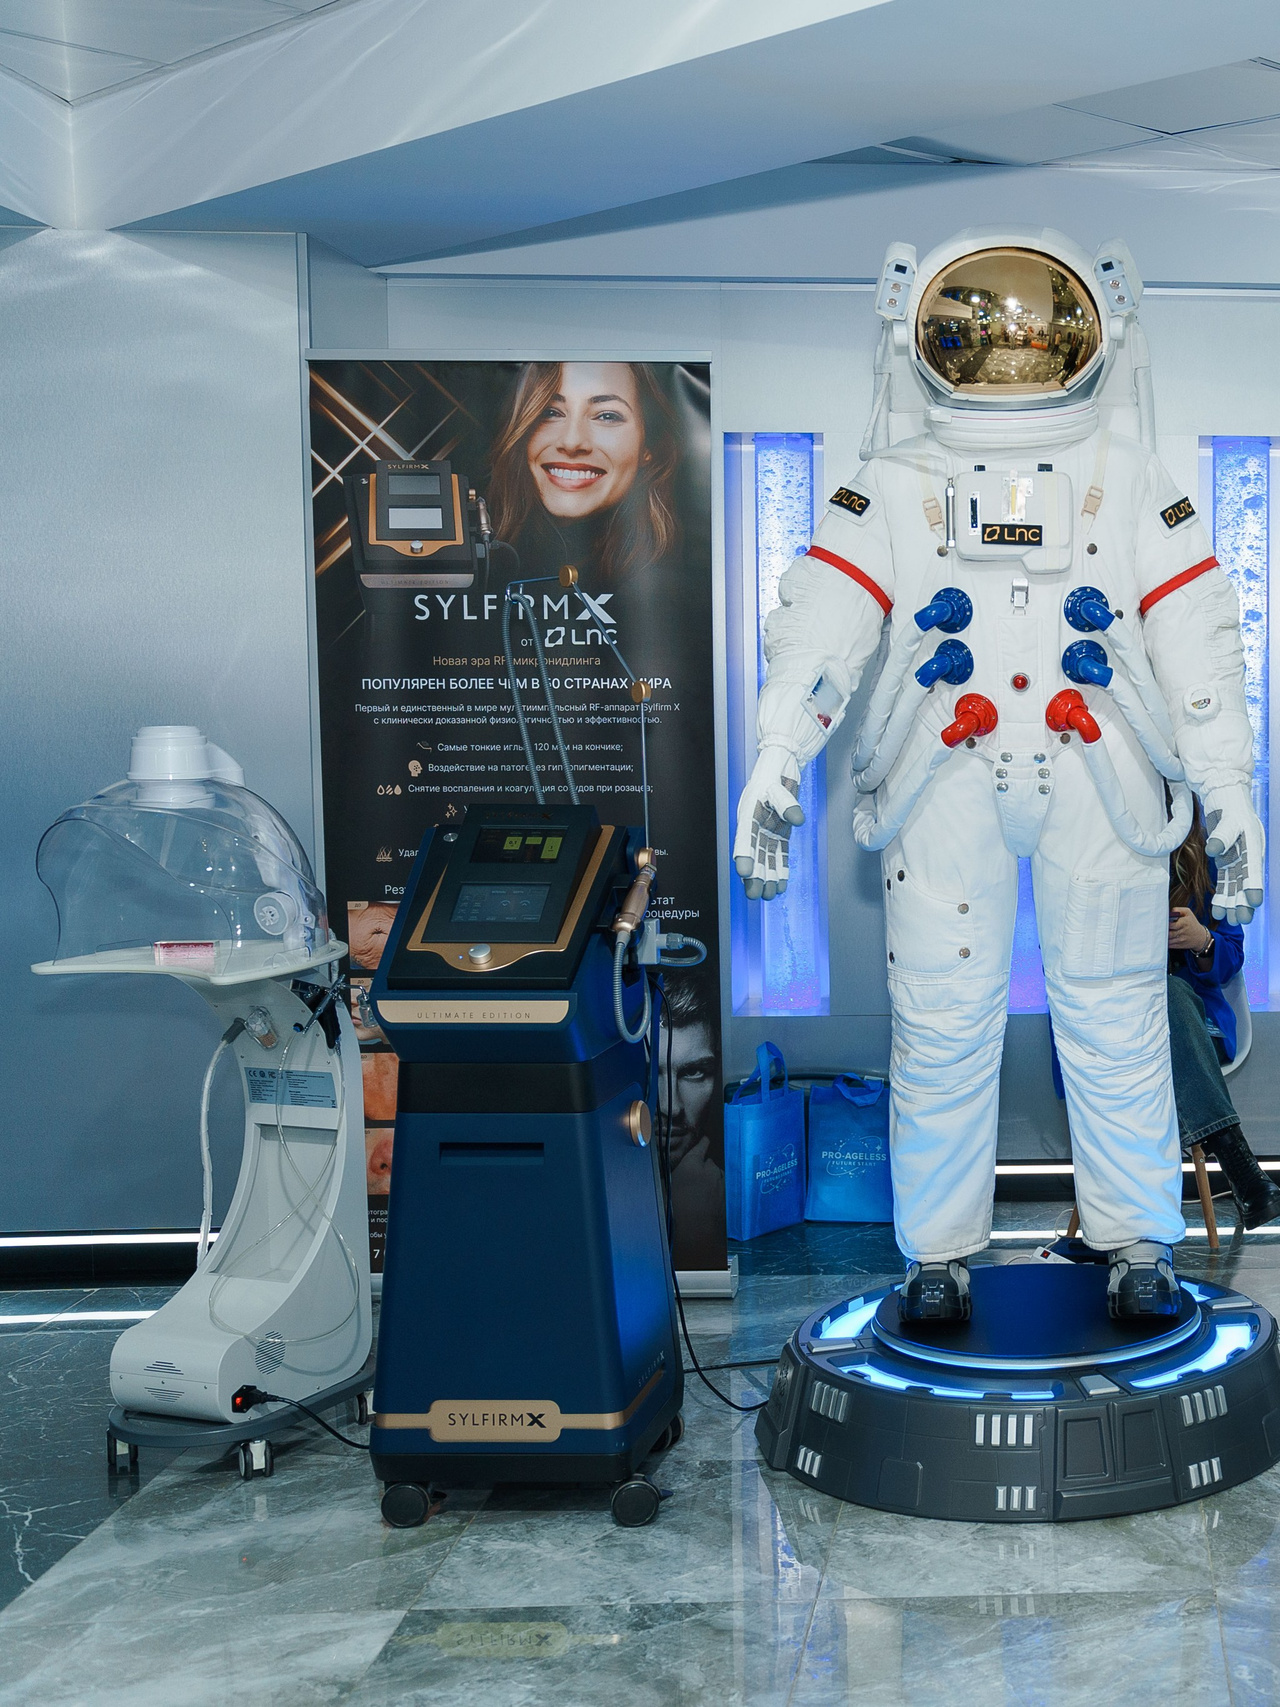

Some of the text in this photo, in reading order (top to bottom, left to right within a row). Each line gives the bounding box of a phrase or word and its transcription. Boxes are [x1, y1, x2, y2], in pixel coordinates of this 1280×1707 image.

[414, 593, 617, 624] SYLFRMX
[520, 638, 534, 647] от
[433, 656, 468, 666] Новая
[470, 656, 491, 667] эра
[361, 678, 446, 690] ПОПУЛЯРЕН
[449, 678, 495, 690] БОЛЕЕ
[531, 678, 540, 690] В
[564, 677, 629, 690] СТРАНАХ
[632, 677, 673, 690] ИРА
[354, 703, 390, 713] Первый
[400, 703, 465, 713] единственный
[474, 705, 498, 714] мире
[589, 704, 640, 714] RF-аппарат
[381, 717, 434, 725] клинически
[435, 716, 487, 726] доказанной
[437, 743, 468, 752] Самые
[470, 744, 501, 752] тонкие
[533, 742, 550, 751] 120
[585, 743, 624, 753] кончике;
[428, 763, 634, 773] Воздействие на патогеез гиппигментации;
[407, 784, 441, 793] Снятие
[442, 785, 495, 794] воспаления
[504, 785, 556, 794] коагулция
[557, 785, 595, 793] содов
[596, 785, 613, 794] при
[821, 1151, 887, 1161] PRO-AGELESS
[755, 1158, 798, 1180] PRO-AGELESS
[448, 1412, 547, 1429] SYLFIRMX
